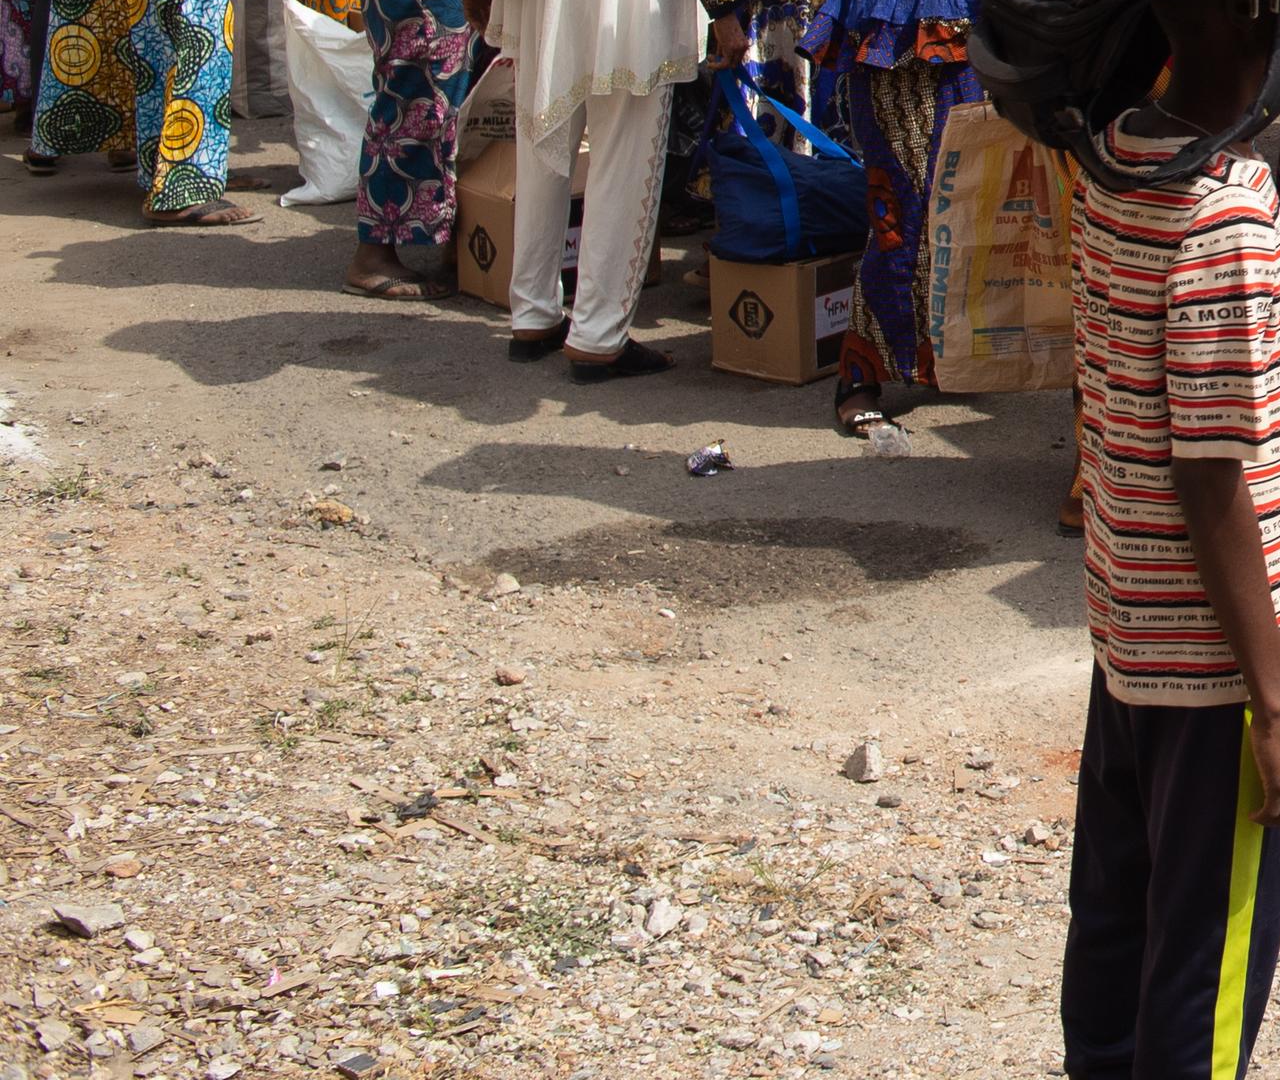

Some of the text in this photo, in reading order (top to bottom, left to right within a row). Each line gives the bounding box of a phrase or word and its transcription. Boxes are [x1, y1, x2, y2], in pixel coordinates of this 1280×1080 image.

[996, 215, 1018, 225] BUA
[929, 150, 960, 359] BUA CEMENT
[1214, 268, 1249, 281] PARIS
[827, 299, 849, 317] HFM
[1198, 305, 1253, 322] MODE
[1170, 380, 1218, 392] FUTURE
[1138, 400, 1161, 410] FOR
[1195, 413, 1223, 421] 1988
[1116, 542, 1172, 554] LIVING FOR
[1142, 614, 1197, 622] LIVING FOR
[1121, 680, 1209, 691] LIVING FOR THE
